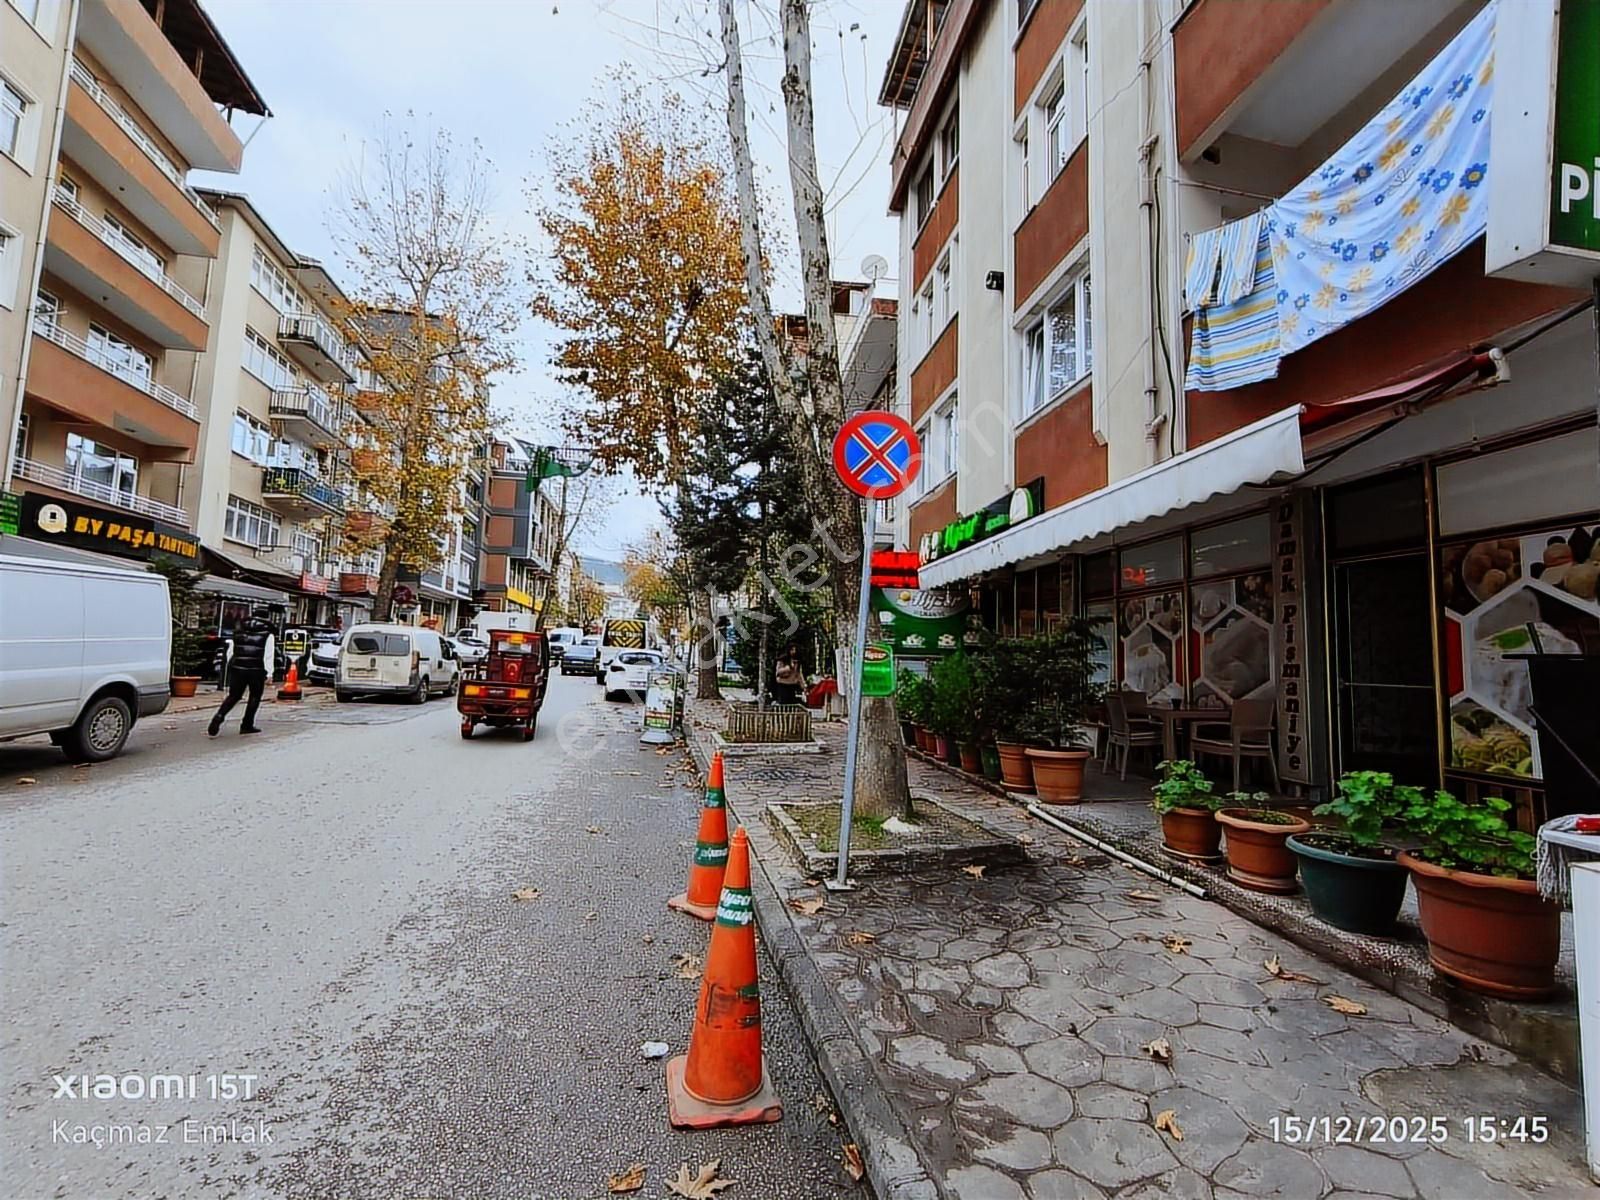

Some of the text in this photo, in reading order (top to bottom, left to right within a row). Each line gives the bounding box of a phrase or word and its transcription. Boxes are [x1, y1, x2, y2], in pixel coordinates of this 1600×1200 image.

[74, 516, 104, 535] BY
[106, 522, 156, 548] PAŞA
[1278, 502, 1297, 593] Damak
